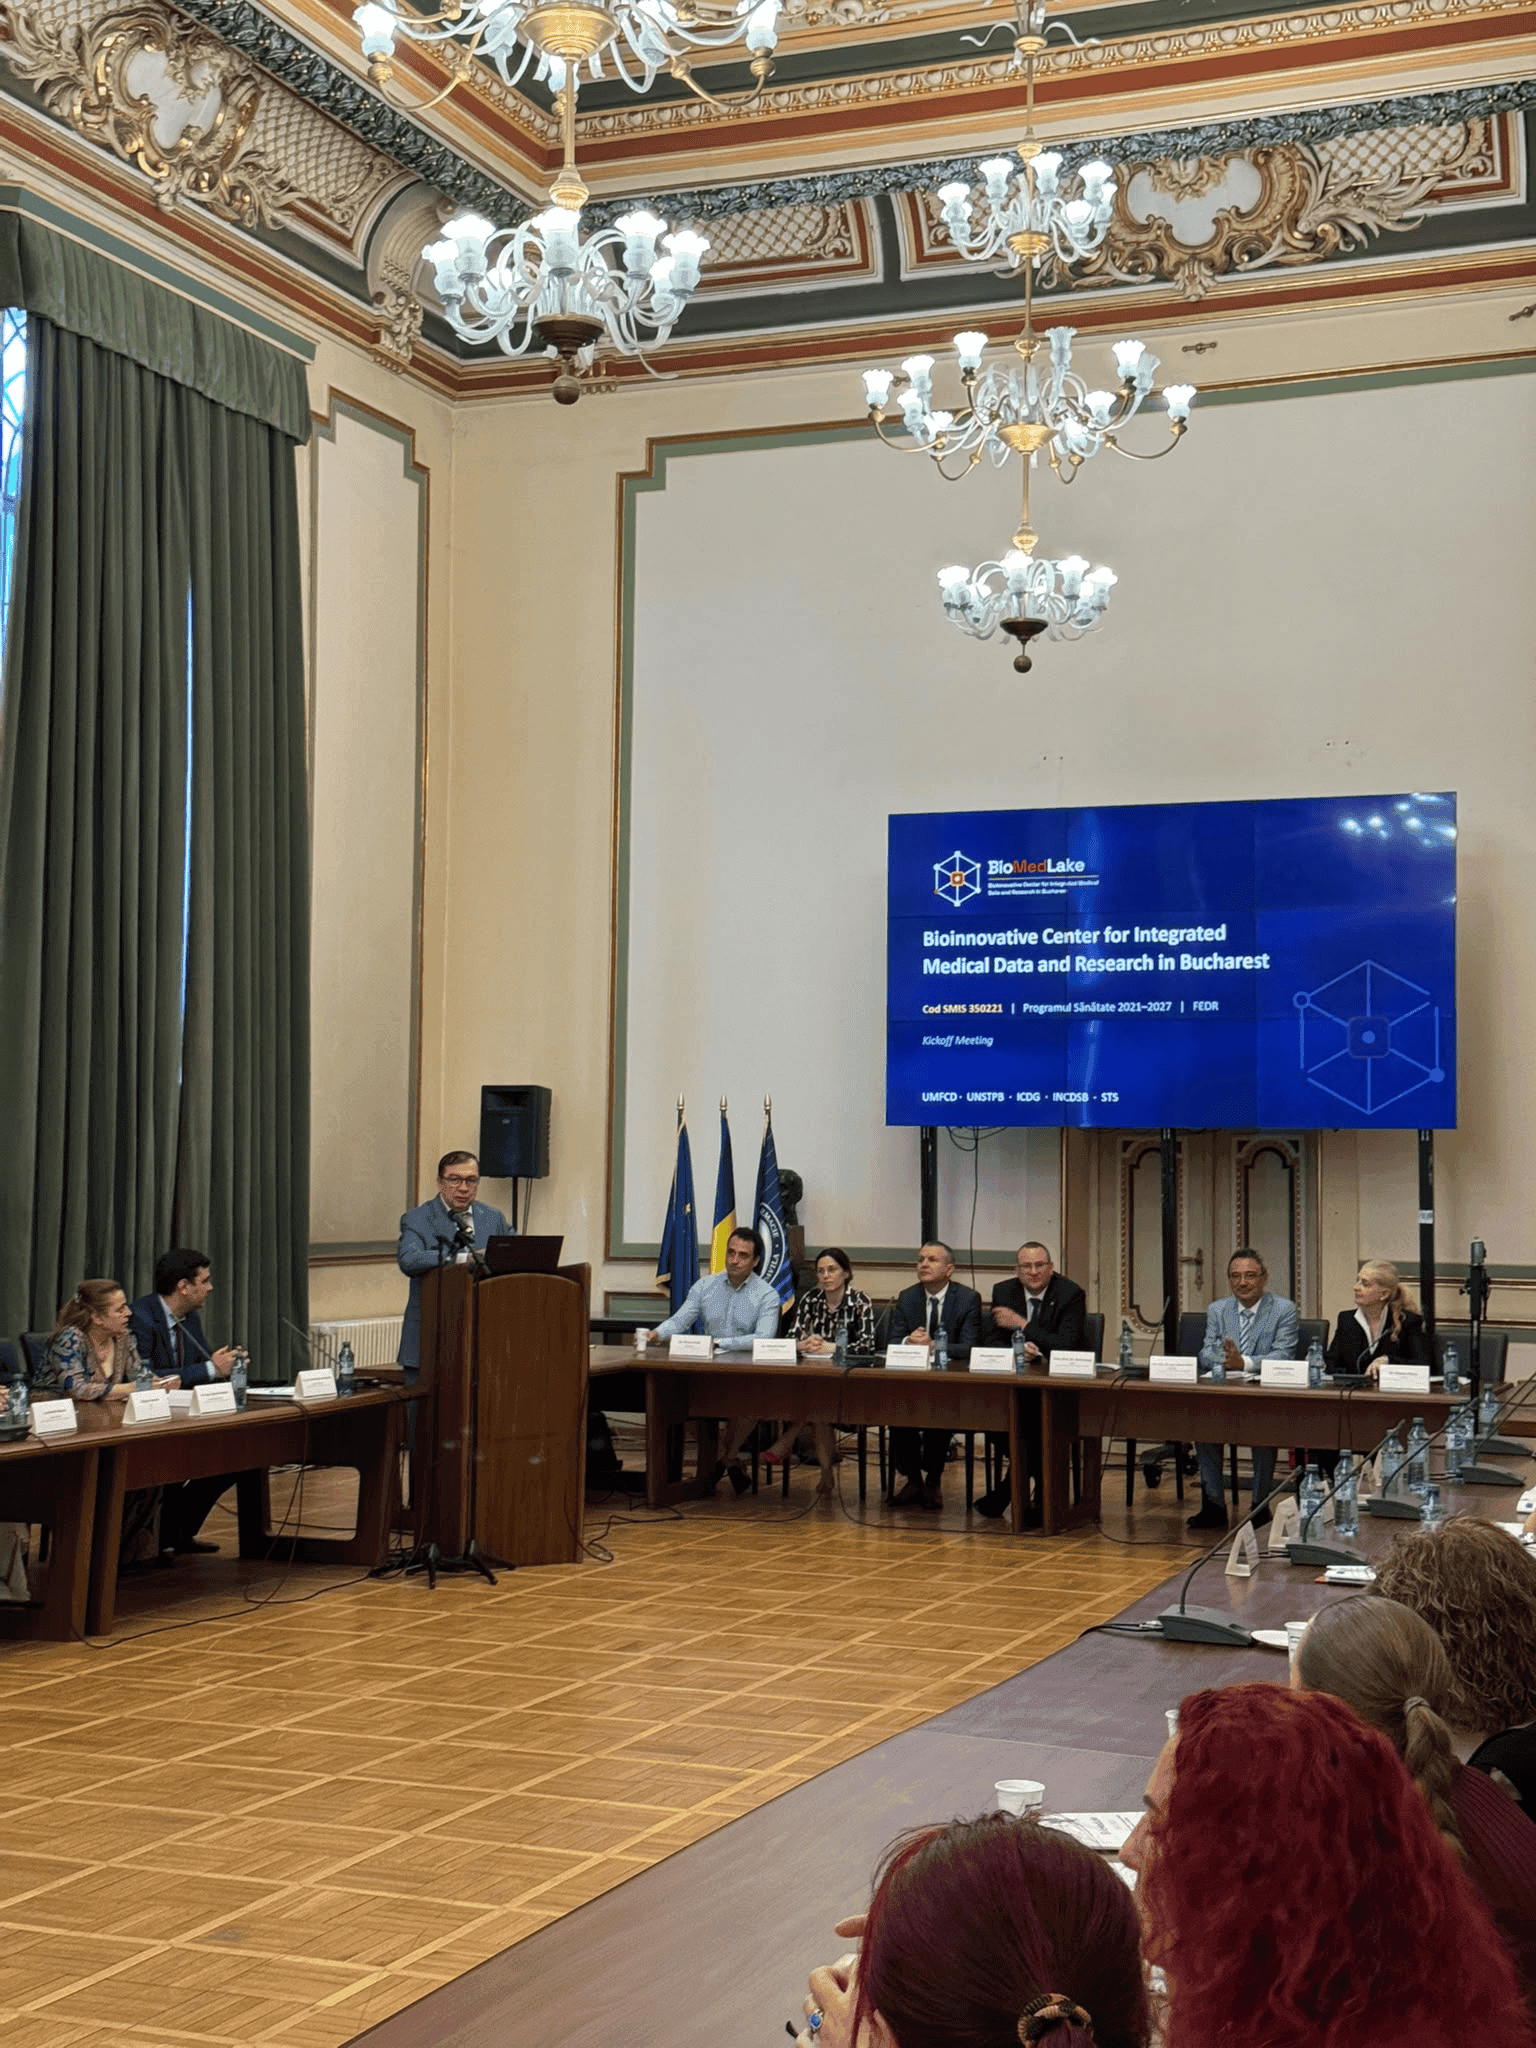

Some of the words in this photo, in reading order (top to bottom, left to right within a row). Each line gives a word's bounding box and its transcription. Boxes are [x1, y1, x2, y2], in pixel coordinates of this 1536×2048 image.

[988, 858, 1085, 874] BioMedLake
[923, 928, 1039, 947] Bioinnovative
[1042, 927, 1101, 945] Center
[1103, 926, 1130, 943] for
[1134, 923, 1227, 946] Integrated
[923, 957, 990, 974] Medical
[994, 957, 1034, 973] Data
[1037, 955, 1071, 973] and
[1075, 953, 1154, 973] Research
[1158, 953, 1175, 971] in
[1180, 952, 1271, 971] Bucharest
[922, 1003, 941, 1014] Cod
[942, 1003, 967, 1014] SMIS
[968, 1003, 1003, 1014] 350221
[1023, 1002, 1072, 1015] Programul
[1193, 1001, 1219, 1011] FEDR
[922, 1035, 955, 1047] Kickoff
[955, 1035, 994, 1047] Meeting
[922, 1092, 957, 1102] UMFCD
[966, 1092, 1005, 1102] UNSTPB
[1016, 1092, 1041, 1102] ICDG
[1052, 1092, 1089, 1102] INCDSB
[1100, 1092, 1119, 1102] STS
